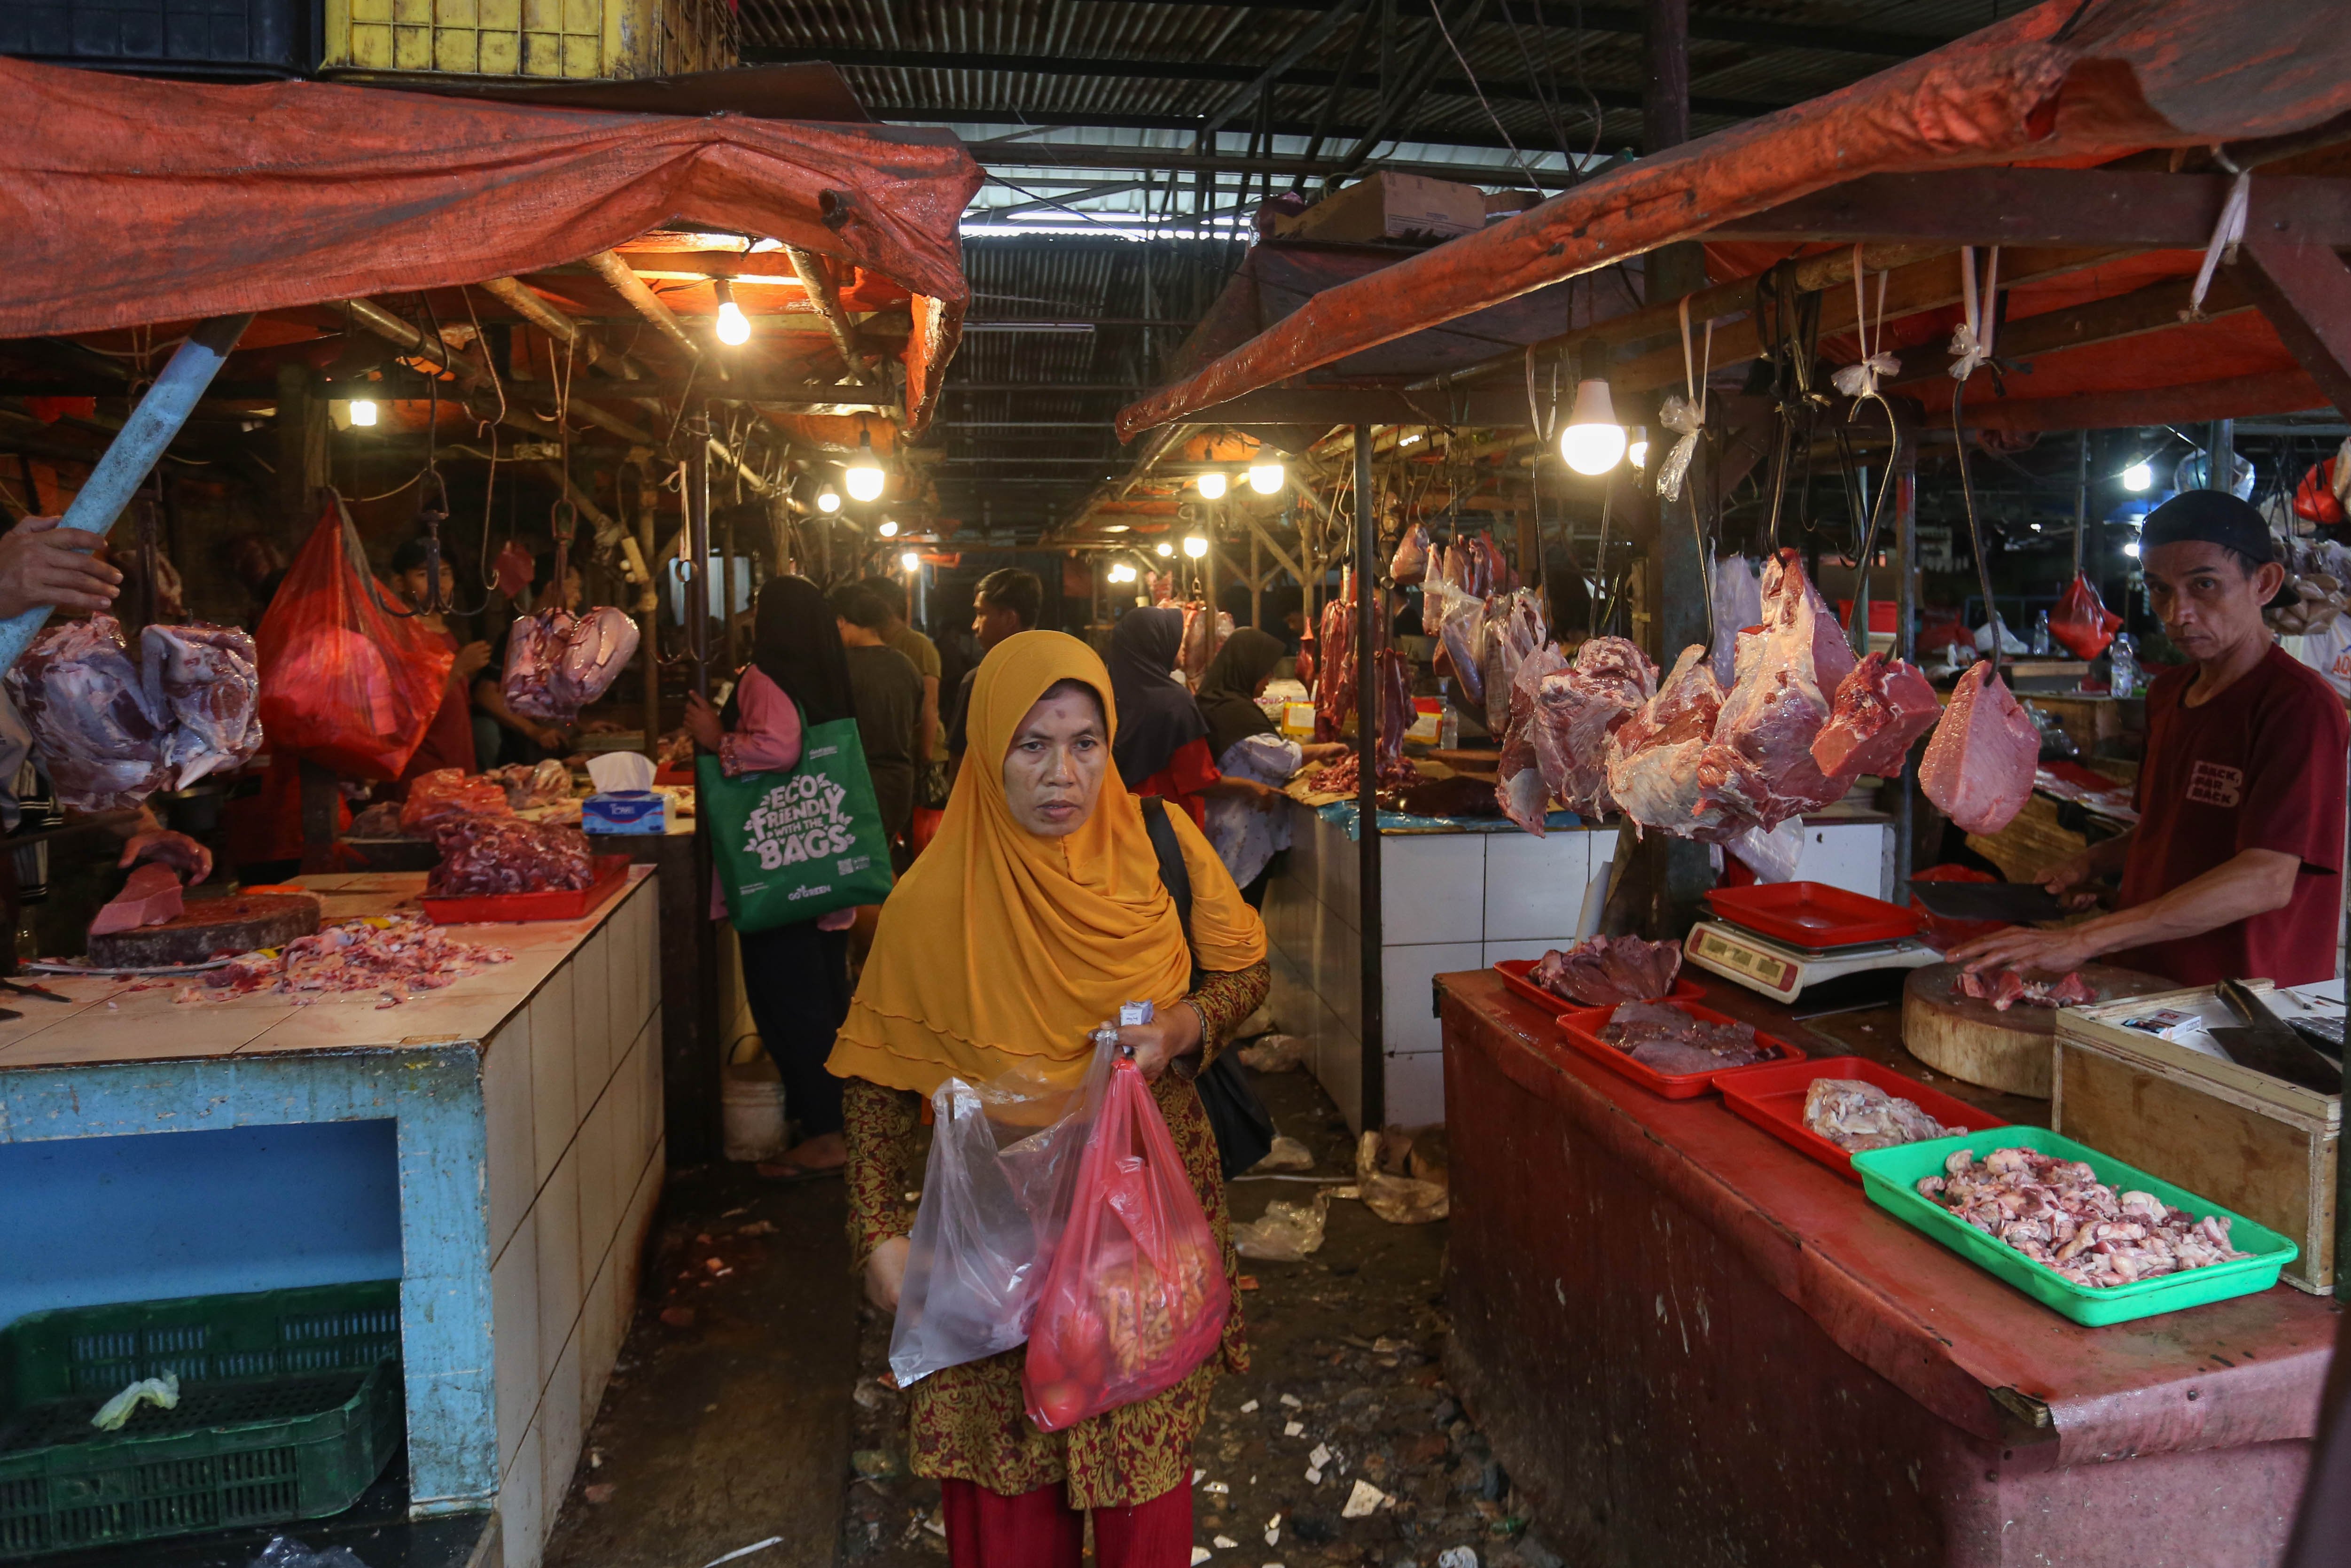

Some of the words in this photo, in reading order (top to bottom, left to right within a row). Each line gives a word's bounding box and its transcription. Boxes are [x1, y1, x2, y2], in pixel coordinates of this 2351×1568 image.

[770, 775, 818, 808] ECO
[773, 821, 801, 836] WITH
[803, 817, 823, 830] THE
[756, 825, 848, 870] BAGS
